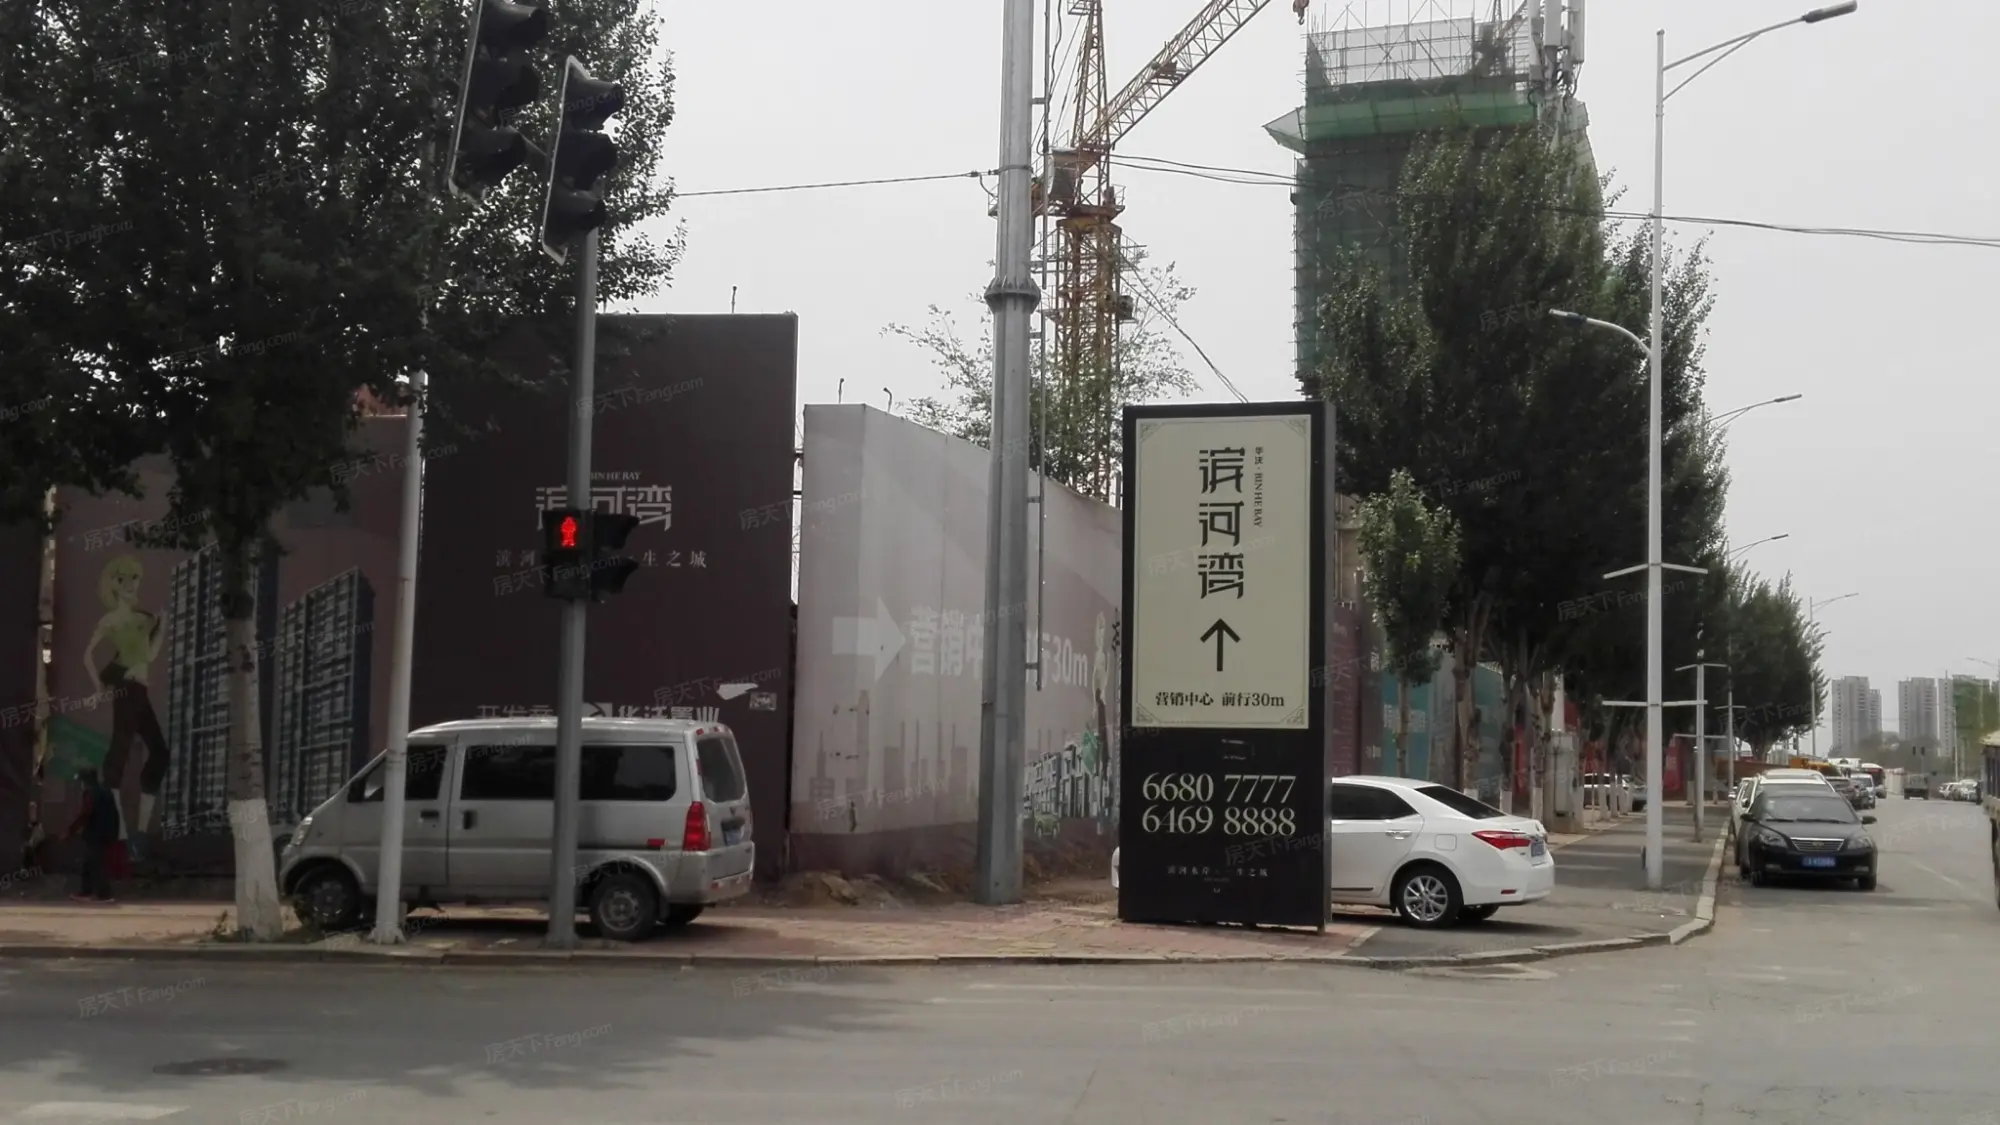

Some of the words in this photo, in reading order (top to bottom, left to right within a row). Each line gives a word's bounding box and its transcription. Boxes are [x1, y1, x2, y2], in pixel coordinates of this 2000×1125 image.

[1198, 446, 1246, 600] 滨河湾
[1156, 691, 1215, 707] 营销中心
[1221, 691, 1285, 707] 前行30m
[1142, 772, 1214, 802] 6680
[1224, 774, 1297, 804] 7777
[1142, 804, 1214, 834] 6469
[1223, 806, 1297, 837] 8888
